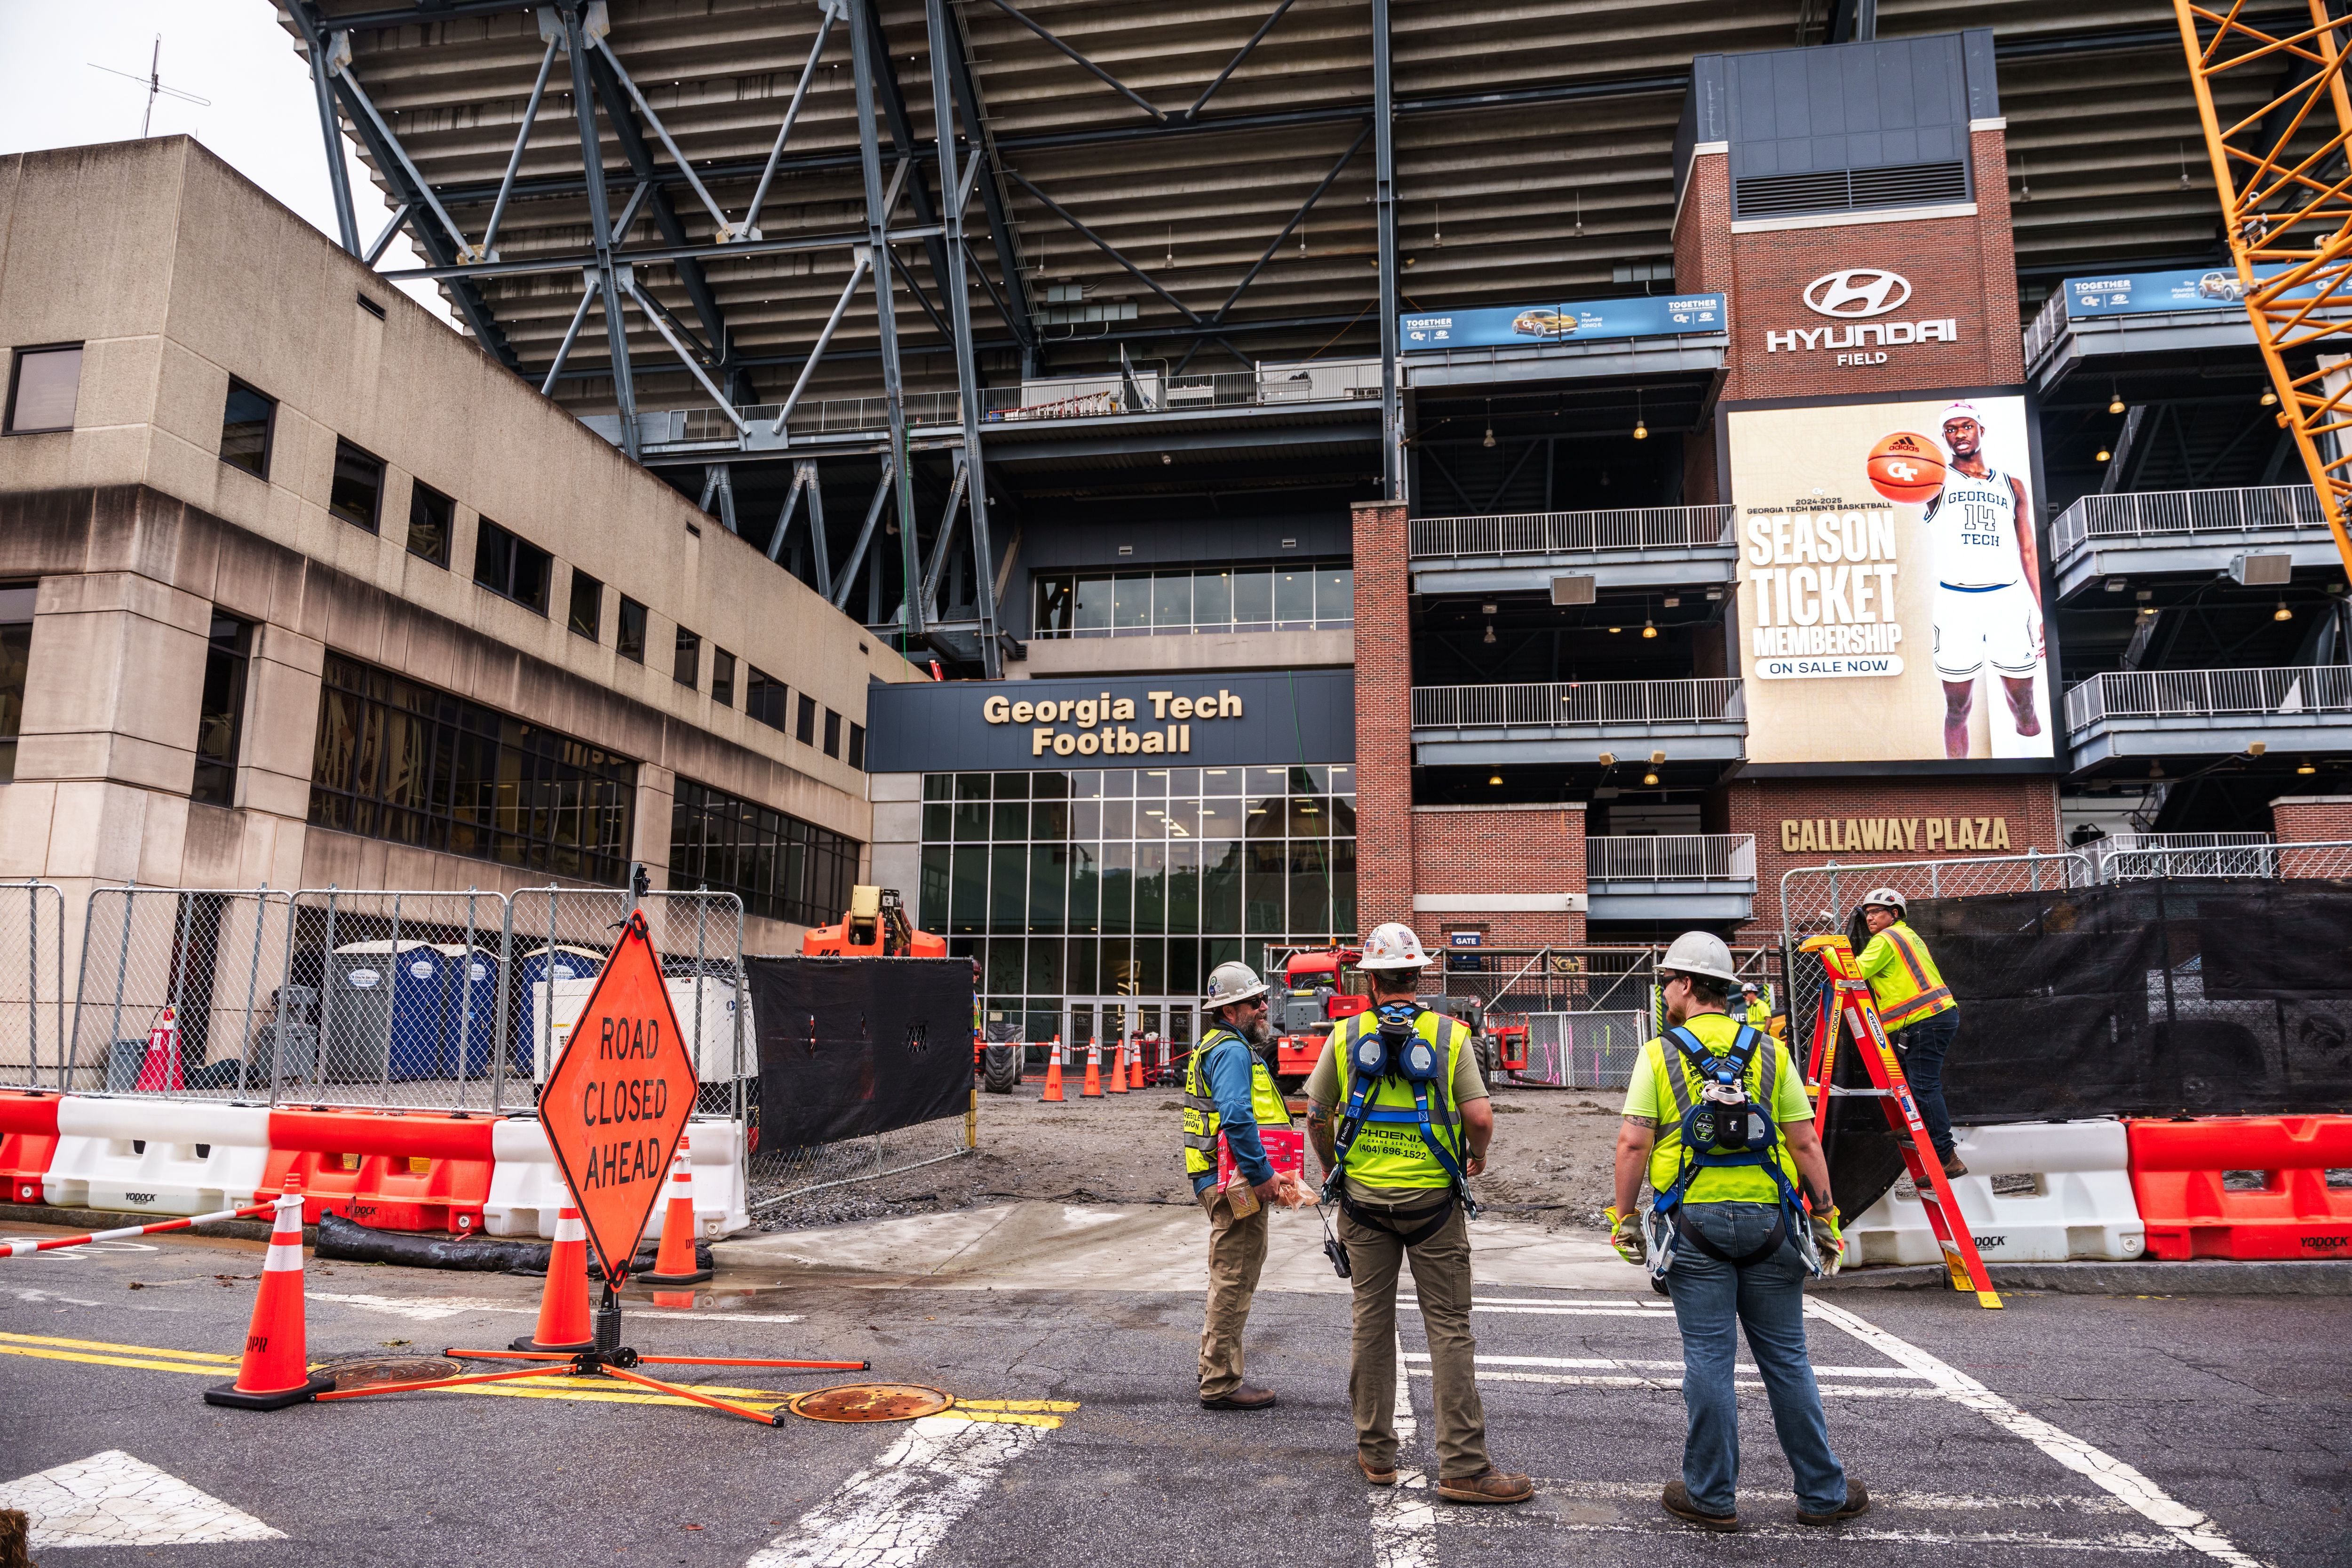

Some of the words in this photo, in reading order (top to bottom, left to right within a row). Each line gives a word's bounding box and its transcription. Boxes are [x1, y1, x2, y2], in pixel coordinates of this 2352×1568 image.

[2074, 279, 2130, 290] TOGETHER
[1668, 299, 1716, 309] TOGETHER
[1406, 318, 1452, 326] TOGETHER
[1411, 332, 1425, 340] GT
[1767, 318, 1957, 352] HYUNDAI
[1837, 352, 1888, 366] FIELD
[1888, 462, 1918, 481] GT
[1948, 491, 2008, 509] GEORGIA
[1964, 504, 1995, 531] 14
[1747, 511, 1897, 565] SEASON
[1962, 534, 1999, 546] TECH
[1749, 564, 1898, 627] TICKET
[1752, 623, 1902, 657] MEMBERSHIP
[1770, 662, 1793, 674] ON
[1799, 661, 1842, 673] SALE
[1848, 660, 1889, 672] NOW
[984, 692, 1136, 728] Georgia
[1148, 689, 1242, 719] Tech
[1033, 724, 1190, 756] Football
[1781, 818, 1918, 852] CALLAWAY
[1926, 817, 2010, 850] PLAZA
[1832, 1009, 1840, 1033] PODIUM
[1869, 1016, 1883, 1042] WERNER
[600, 1017, 659, 1060] ROAD
[584, 1079, 667, 1126] CLOSED
[1359, 1129, 1425, 1143] PHOENIX
[1359, 1144, 1380, 1155] (404)
[1383, 1147, 1426, 1160] 696-1522
[584, 1138, 660, 1192] AHEAD
[126, 1193, 155, 1202] YODOCK
[345, 1205, 377, 1215] YDOCK
[1972, 1236, 2005, 1247] DOCK
[2300, 1237, 2349, 1247] YODOCK
[246, 1336, 268, 1353] DPR
